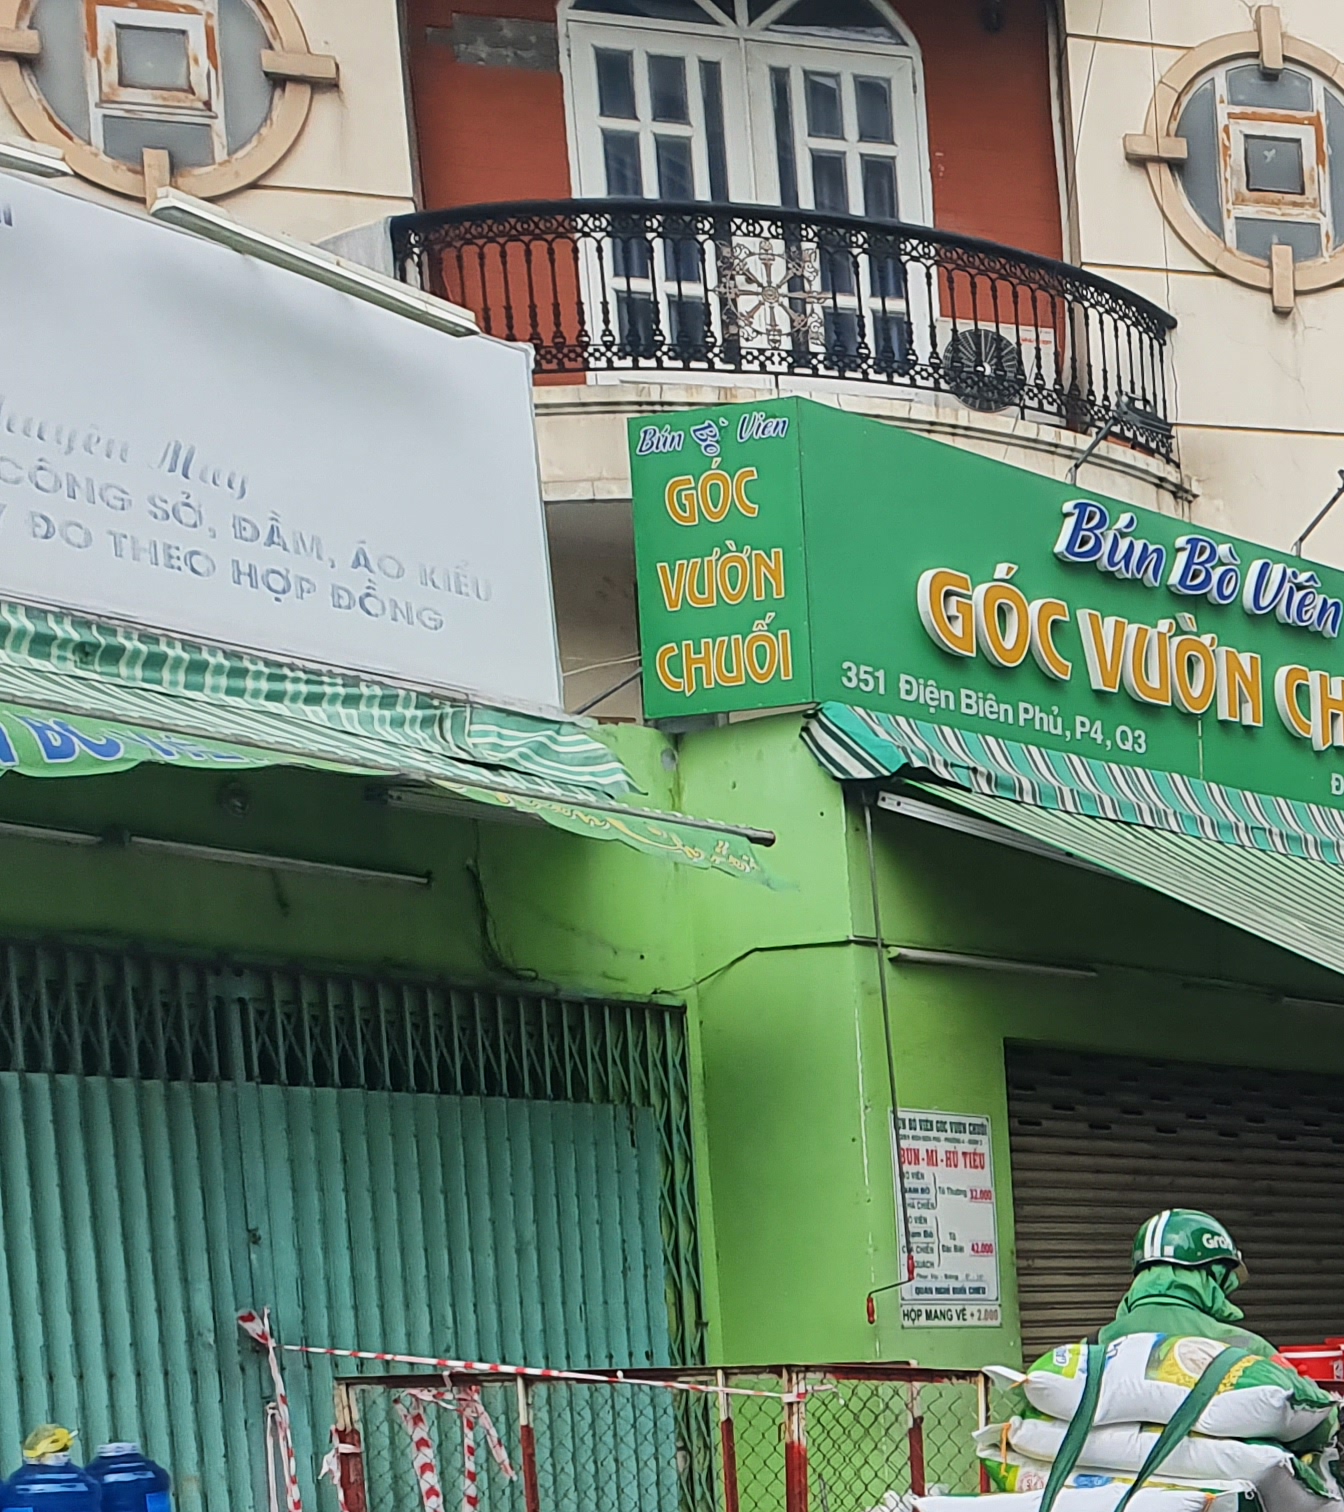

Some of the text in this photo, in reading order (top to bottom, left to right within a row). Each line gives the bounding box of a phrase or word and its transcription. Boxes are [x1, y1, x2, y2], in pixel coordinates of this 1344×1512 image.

[636, 424, 685, 456] Bún
[0, 456, 133, 512] CÔNG
[665, 457, 759, 526] GÓC
[28, 510, 445, 633] ĐO THEO HỢP ĐỒNG
[656, 540, 785, 612] VƯỜN
[1053, 499, 1343, 638] Bún Bò Viên
[655, 612, 793, 698] CHUỐI
[917, 562, 1072, 682] GÓC
[1076, 608, 1264, 728] VƯỜN
[841, 661, 886, 695] 351
[899, 673, 955, 714] Điện
[961, 688, 1014, 725] Biên
[1115, 725, 1148, 754] Q3
[925, 1309, 953, 1321] MANG
